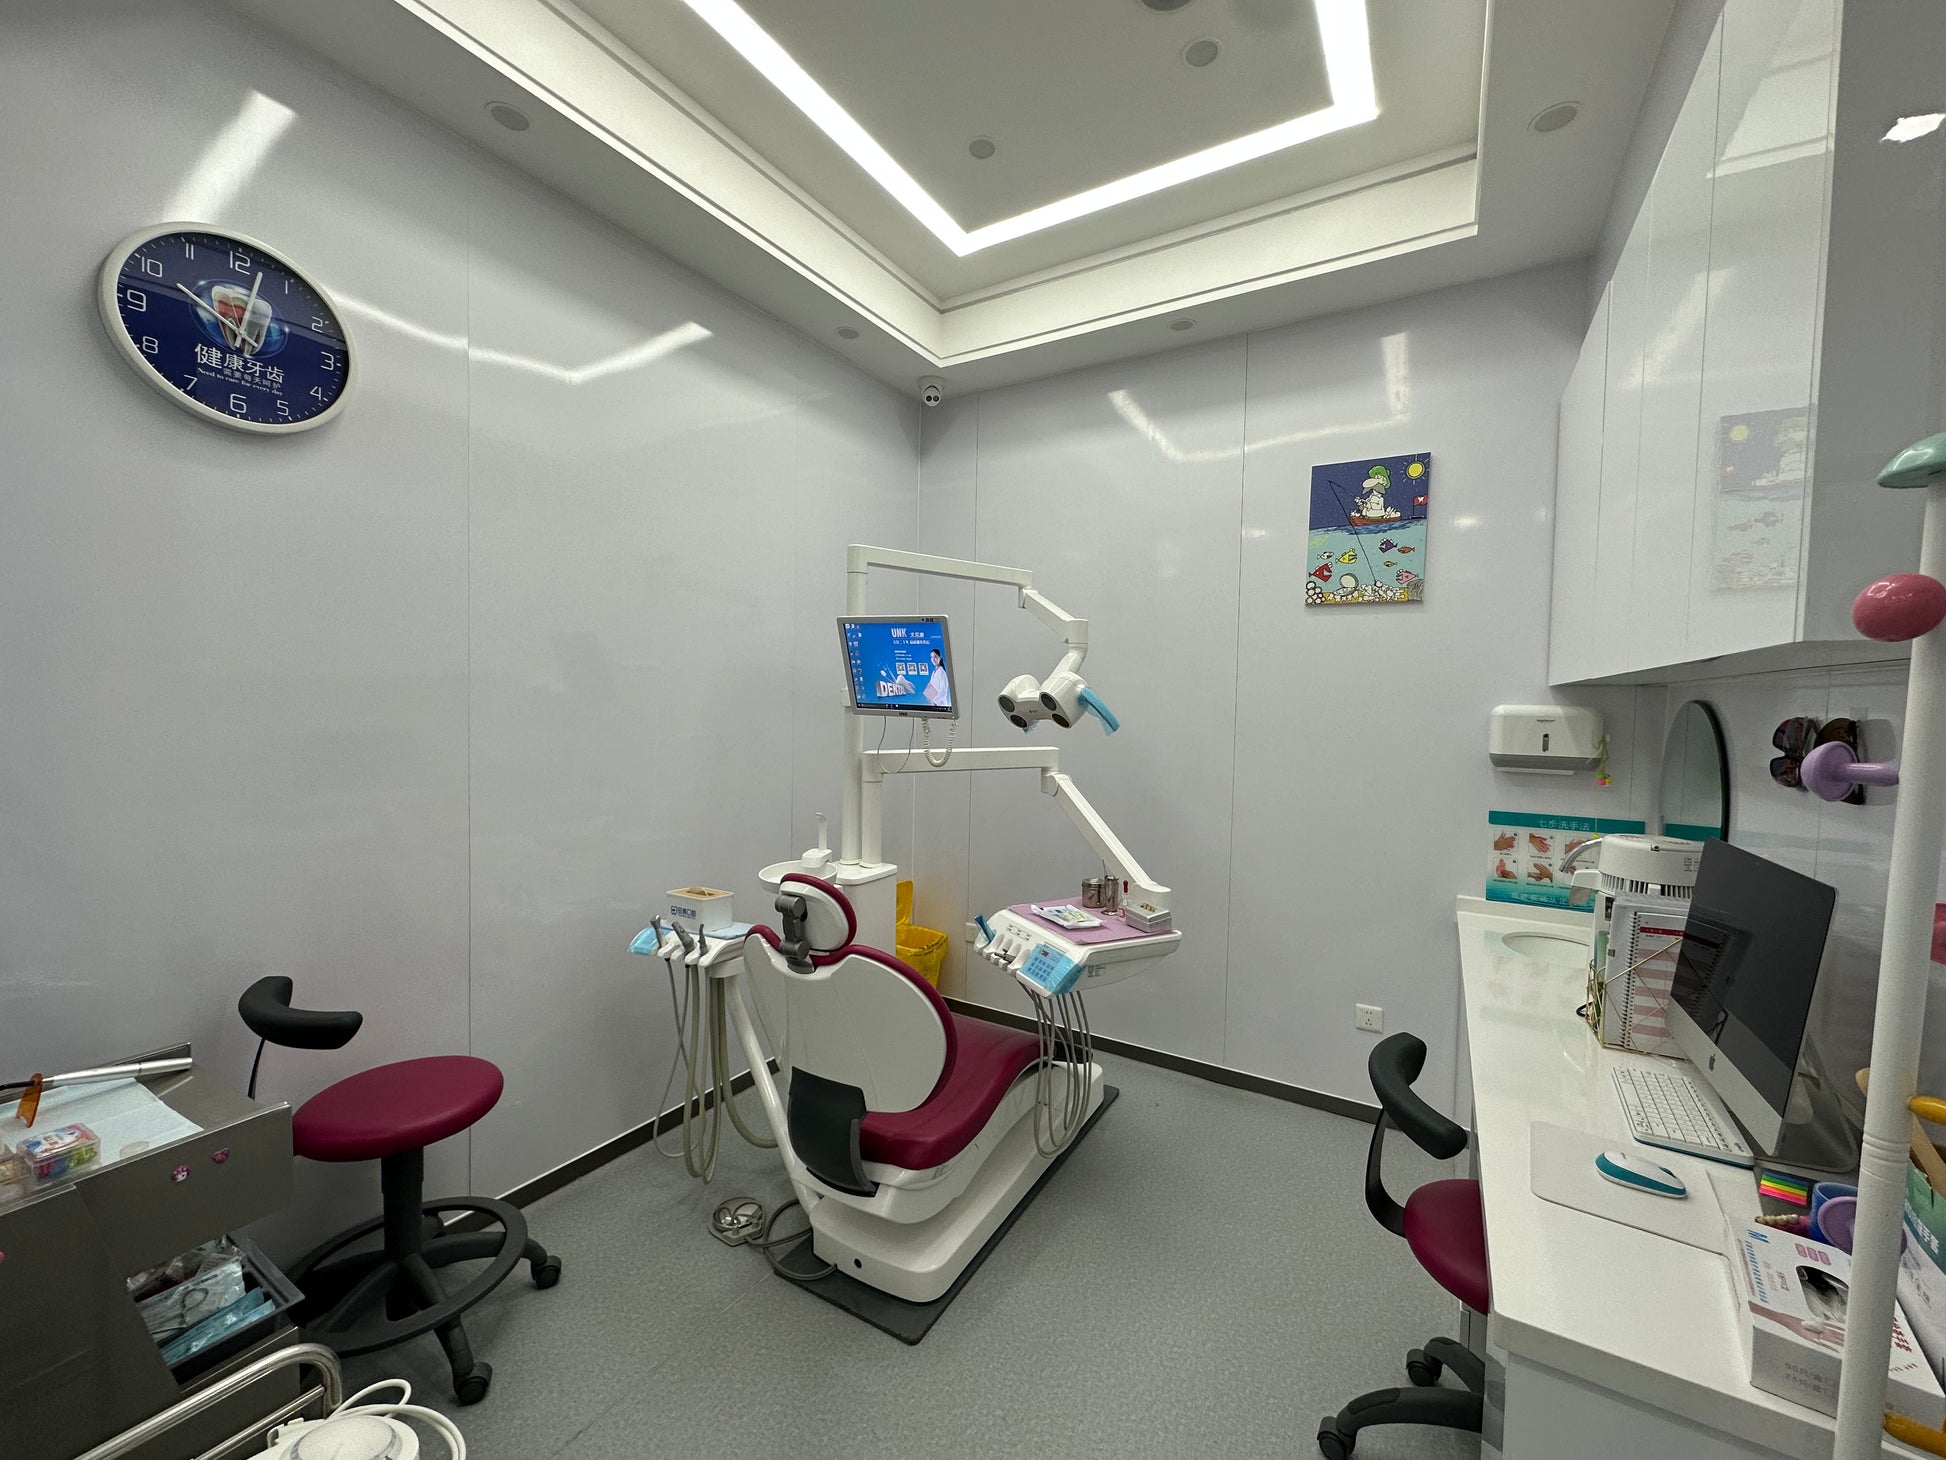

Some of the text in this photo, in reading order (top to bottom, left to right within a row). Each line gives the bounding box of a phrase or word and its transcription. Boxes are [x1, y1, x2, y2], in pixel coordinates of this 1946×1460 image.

[185, 242, 195, 261] 11
[140, 256, 163, 278] 10
[229, 250, 251, 275] 12
[126, 289, 147, 313] 9
[311, 316, 324, 333] 2
[142, 336, 159, 355] 8
[194, 343, 285, 384] 健康牙齿
[320, 351, 335, 371] 3
[183, 373, 199, 391] 7
[197, 367, 216, 378] Need
[309, 386, 322, 400] 4
[229, 393, 247, 414] 6
[276, 400, 289, 416] 5
[891, 628, 907, 638] UNK
[1537, 819, 1591, 831] 七步洗手法
